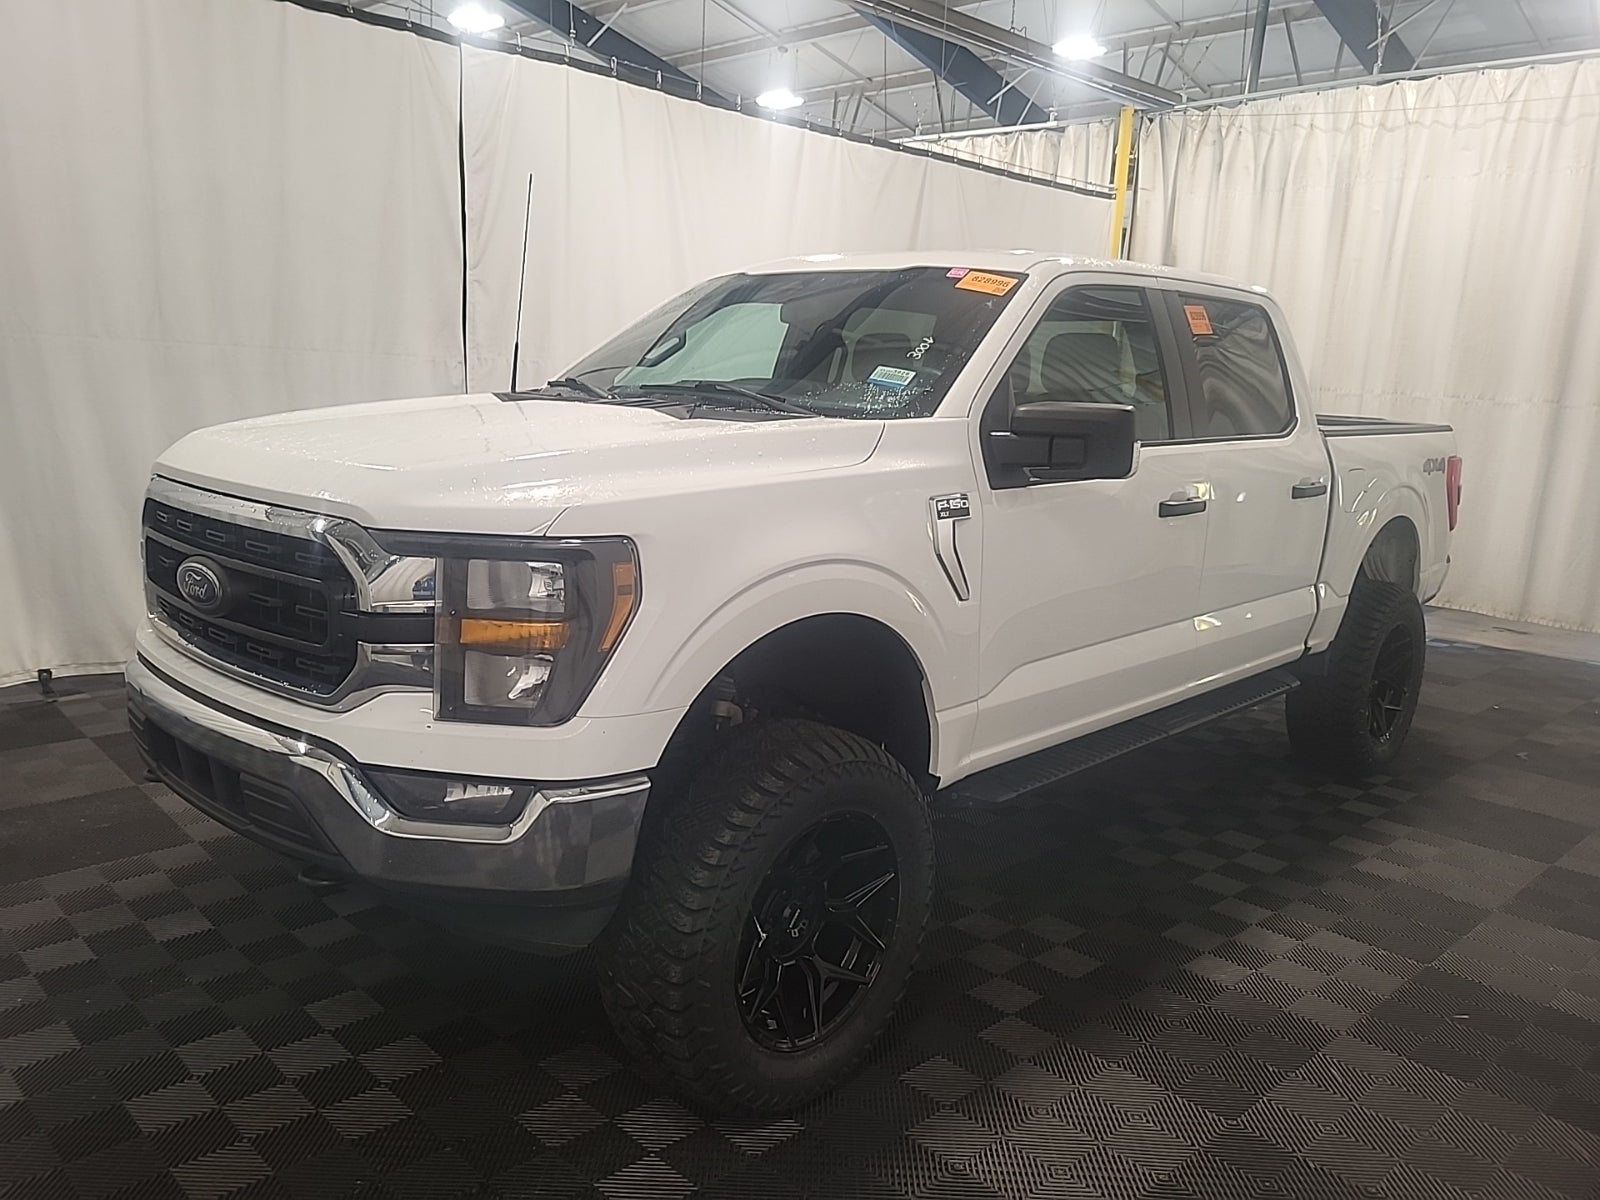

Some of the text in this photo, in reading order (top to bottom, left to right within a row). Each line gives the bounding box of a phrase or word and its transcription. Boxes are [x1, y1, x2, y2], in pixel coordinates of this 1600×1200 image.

[971, 275, 1012, 288] 828996
[937, 499, 969, 511] F-150
[183, 571, 208, 599] Ford
